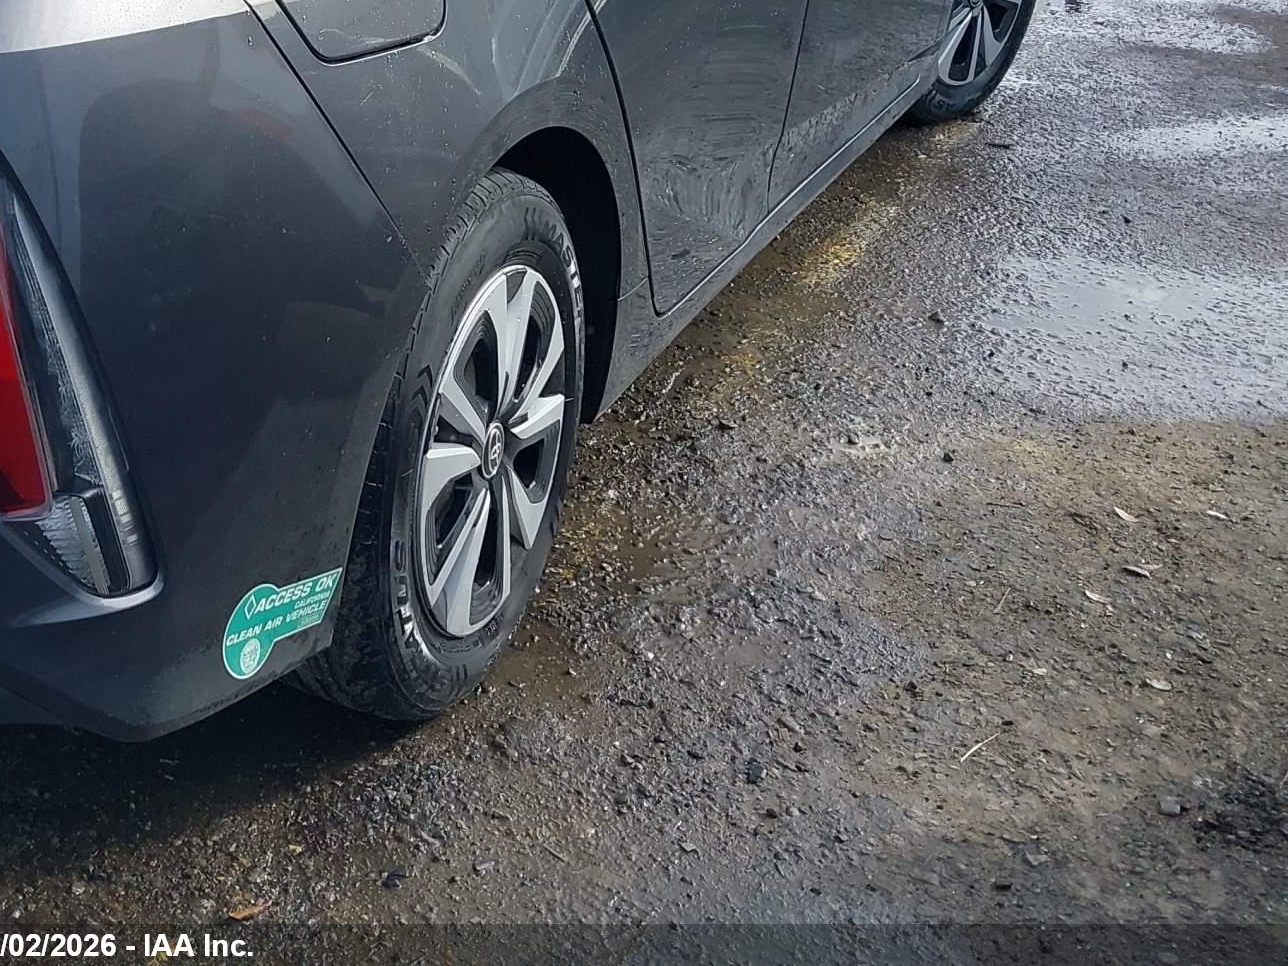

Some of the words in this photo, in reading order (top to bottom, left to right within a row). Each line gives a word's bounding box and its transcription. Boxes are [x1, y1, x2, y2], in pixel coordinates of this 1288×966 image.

[253, 581, 313, 615] ACCESS
[314, 573, 337, 592] OK
[294, 590, 331, 609] CALIFORNIA
[225, 623, 263, 647] CLEAN
[263, 615, 283, 632] AIR
[285, 599, 328, 623] VEHICLE
